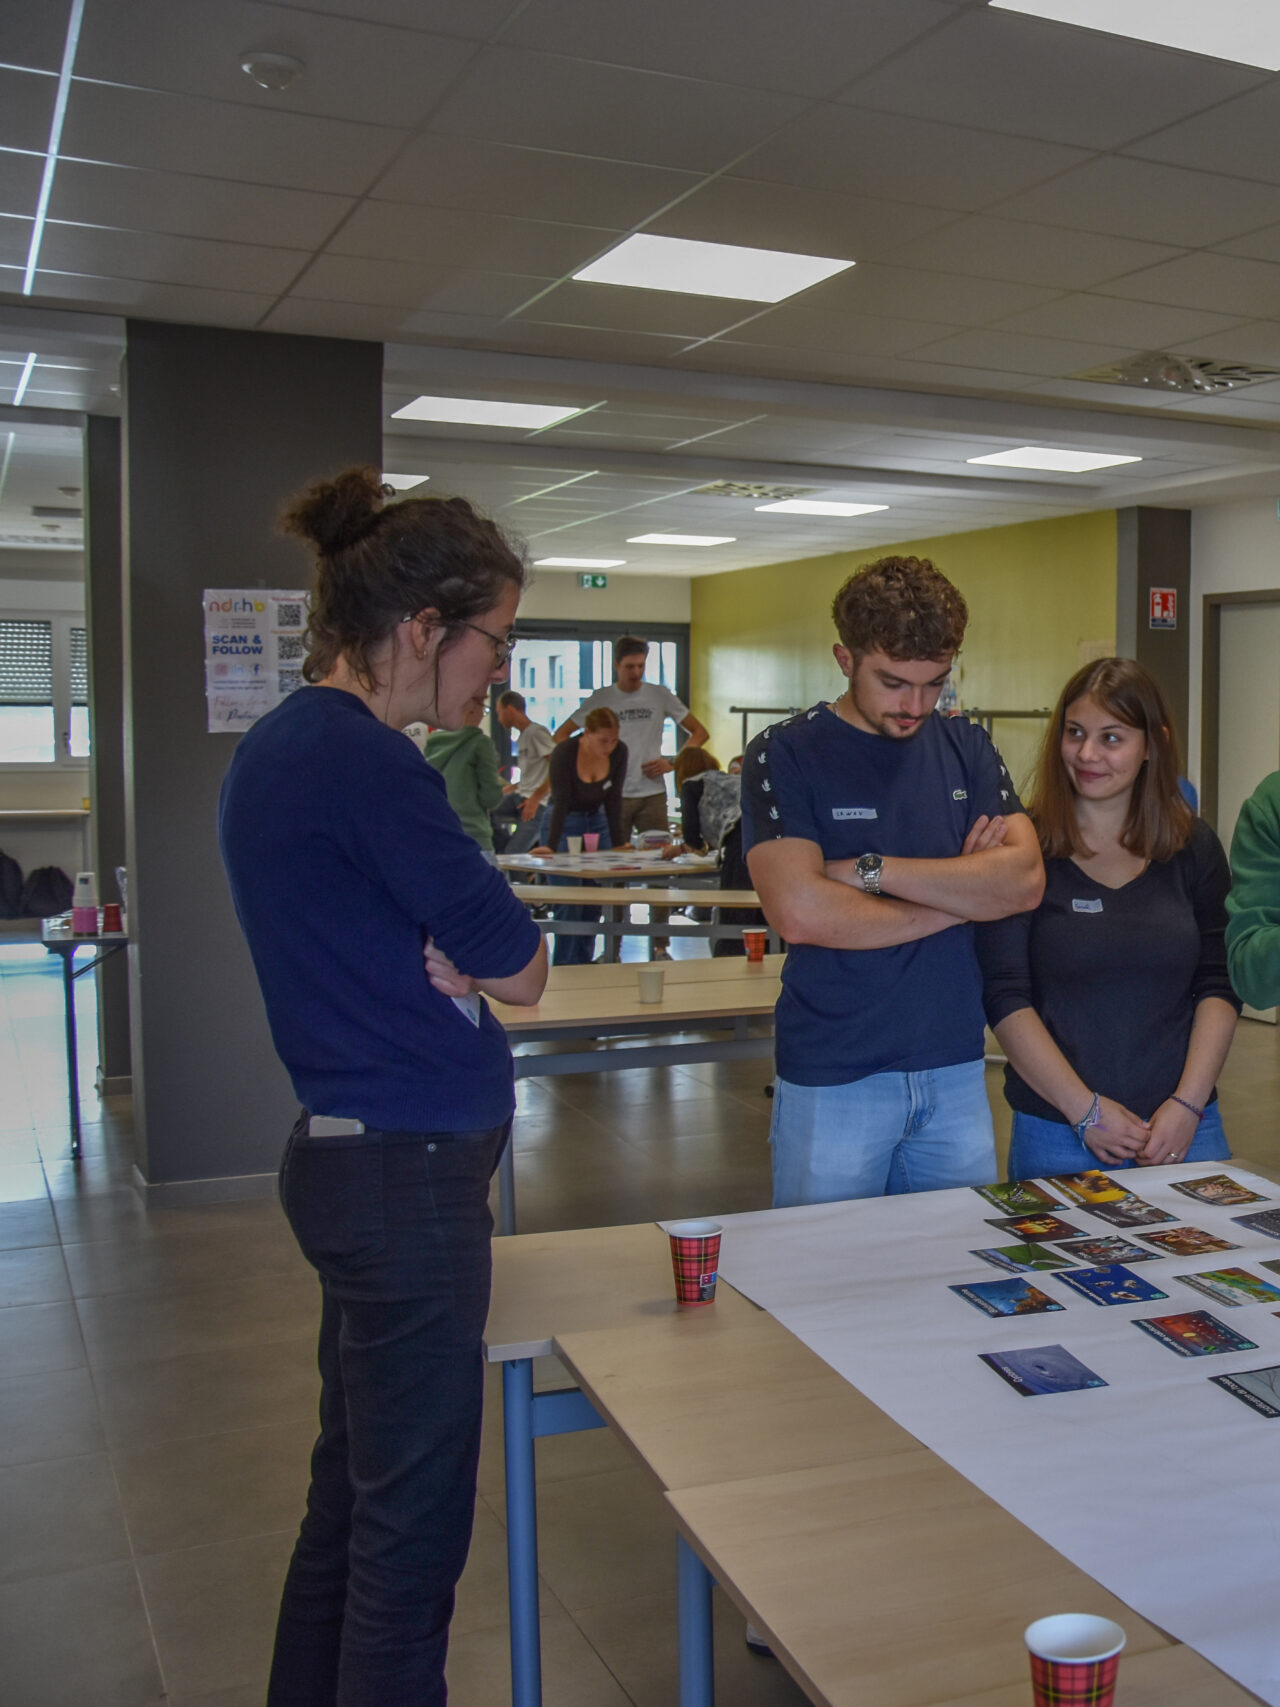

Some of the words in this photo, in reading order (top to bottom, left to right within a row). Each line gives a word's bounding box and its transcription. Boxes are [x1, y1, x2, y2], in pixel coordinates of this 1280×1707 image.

[212, 635, 248, 644] SCAN
[252, 635, 262, 644] &
[212, 646, 263, 655] FOLLOW
[998, 1365, 1026, 1382] Cyclones
[1240, 1393, 1279, 1414] Acidification
